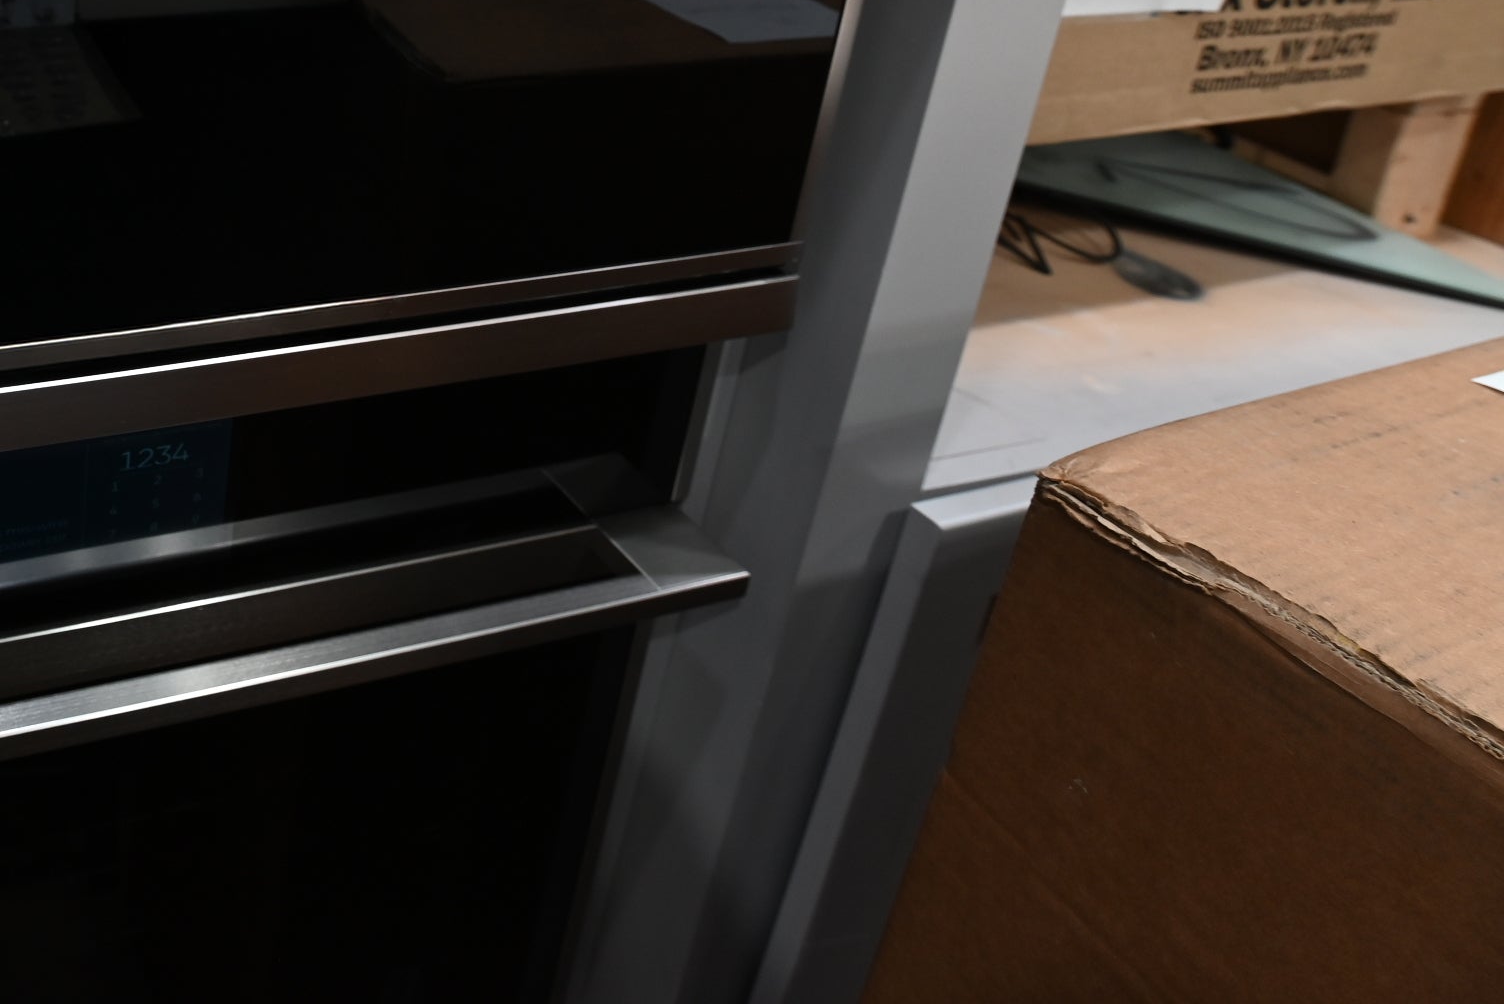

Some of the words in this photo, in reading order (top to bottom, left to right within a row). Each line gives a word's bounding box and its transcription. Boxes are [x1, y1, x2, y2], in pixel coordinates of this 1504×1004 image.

[1197, 44, 1269, 72] Bronx,
[1274, 36, 1308, 65] NY
[119, 443, 191, 472] 1234
